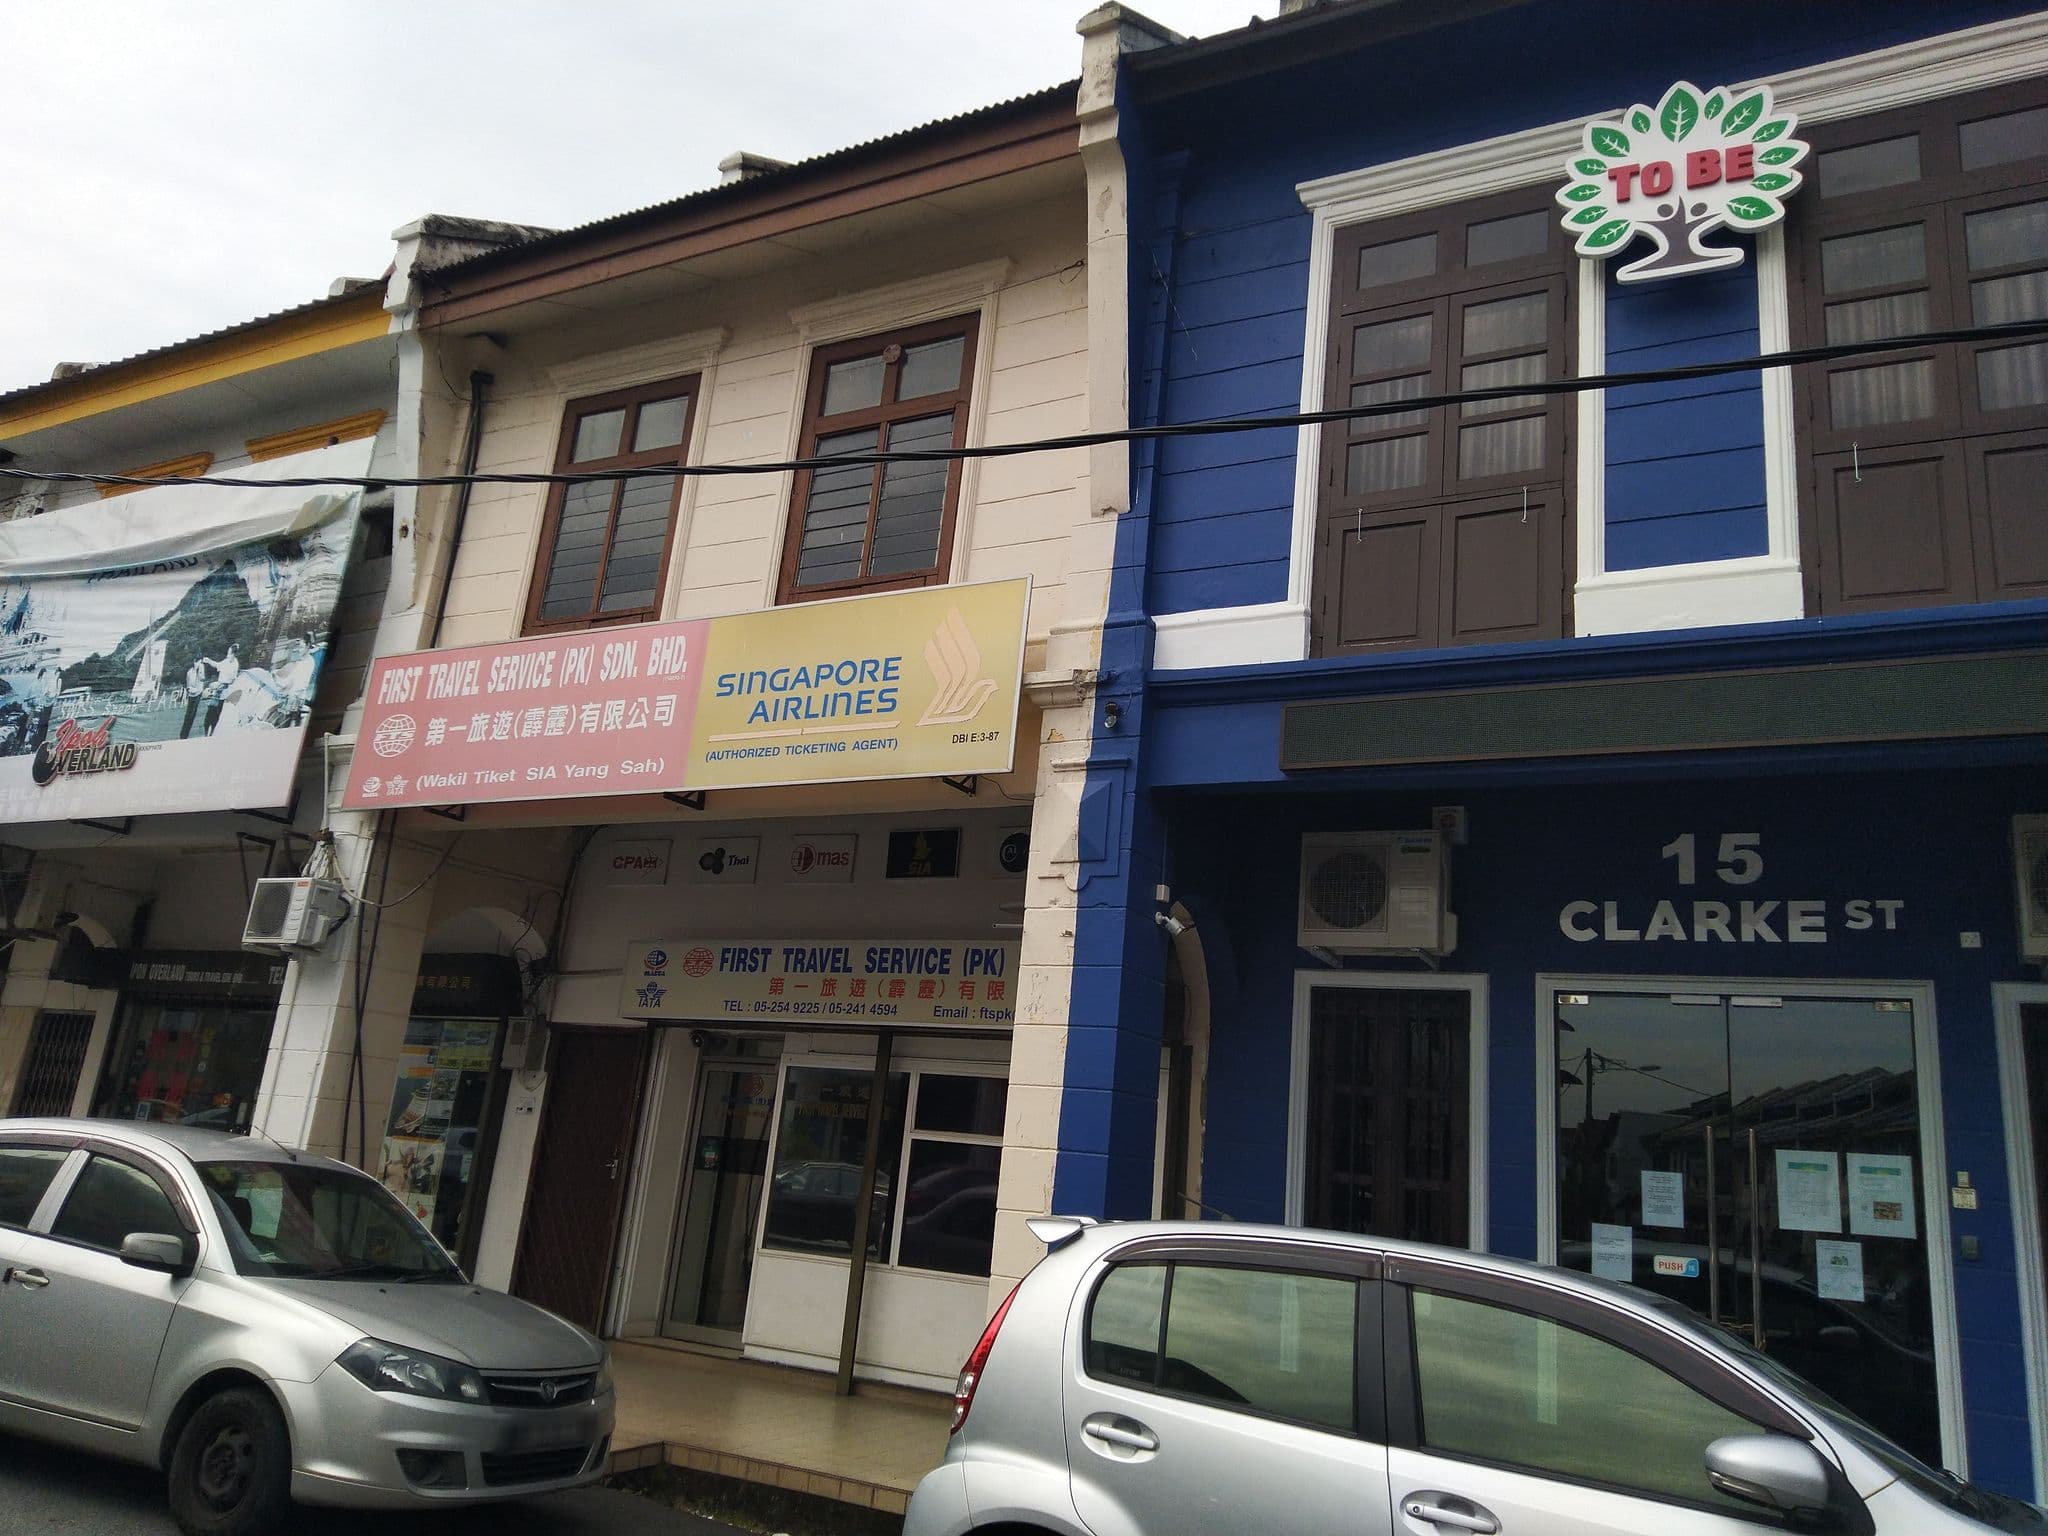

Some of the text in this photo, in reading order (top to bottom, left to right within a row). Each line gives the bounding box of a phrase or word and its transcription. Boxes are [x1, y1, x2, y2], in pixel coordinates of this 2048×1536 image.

[1608, 143, 1755, 204] TO BE
[377, 635, 688, 705] FIRST TRAVEL SERVICE (PK) SDN. BHD.
[716, 656, 902, 698] SINGAPORE
[747, 687, 899, 725] AIRLINES
[705, 737, 899, 763] (AUTHORIZED TICKETING AGENT)
[416, 756, 666, 792] (Wakil Tiket SIA Yang Sah)
[728, 854, 750, 866] Thai
[816, 851, 850, 867] mas
[1661, 832, 1764, 885] 15
[1558, 899, 1905, 943] CLARKE ST
[719, 947, 1006, 978] FIRST TRAVEL SERVICE (PK)
[638, 995, 662, 1009] IATA
[754, 1001, 790, 1014] 05-254
[793, 1002, 820, 1015] 9225
[829, 1002, 866, 1015] 05-241
[869, 1003, 898, 1016] 4594
[1658, 1261, 1684, 1271] PUSH
